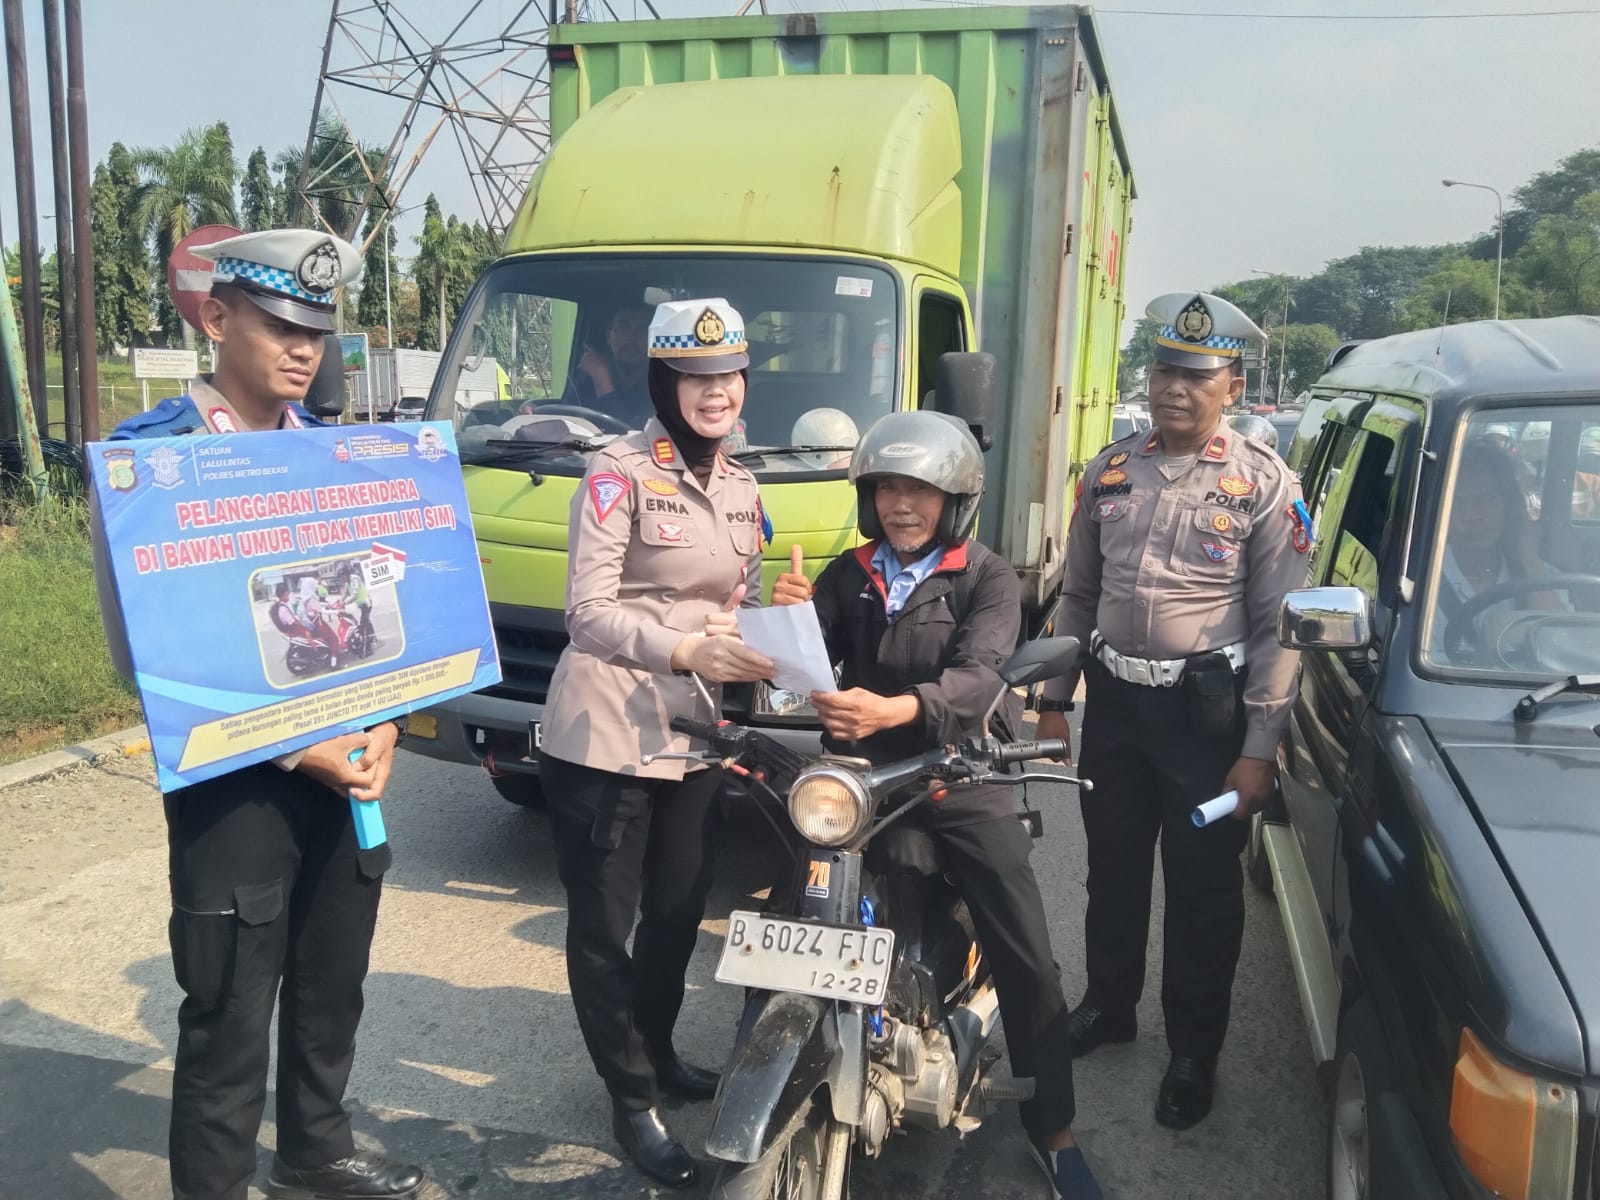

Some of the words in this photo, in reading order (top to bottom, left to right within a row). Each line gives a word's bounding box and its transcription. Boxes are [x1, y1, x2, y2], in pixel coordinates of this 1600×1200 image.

[199, 447, 232, 456] SATUAN
[201, 459, 222, 468] LALU
[222, 457, 251, 467] LINTAS
[203, 471, 234, 481] POLRES
[235, 468, 262, 479] METRO
[262, 466, 289, 476] BEKASI
[176, 495, 313, 529] PELANGGARAN
[315, 478, 420, 512] BERKENDARA
[646, 498, 689, 516] ERNA
[1204, 491, 1257, 513] POLRI
[134, 544, 160, 574] DI
[163, 534, 235, 570] BAWAH
[242, 525, 293, 557] UMUR
[296, 518, 352, 552] (TIDAK
[355, 508, 423, 539] MEMILIKI
[424, 504, 457, 530] SIM)
[371, 564, 389, 579] SIM
[808, 860, 830, 887] 70
[731, 919, 747, 947] B
[761, 923, 824, 956] 6024
[838, 932, 887, 966] FIC
